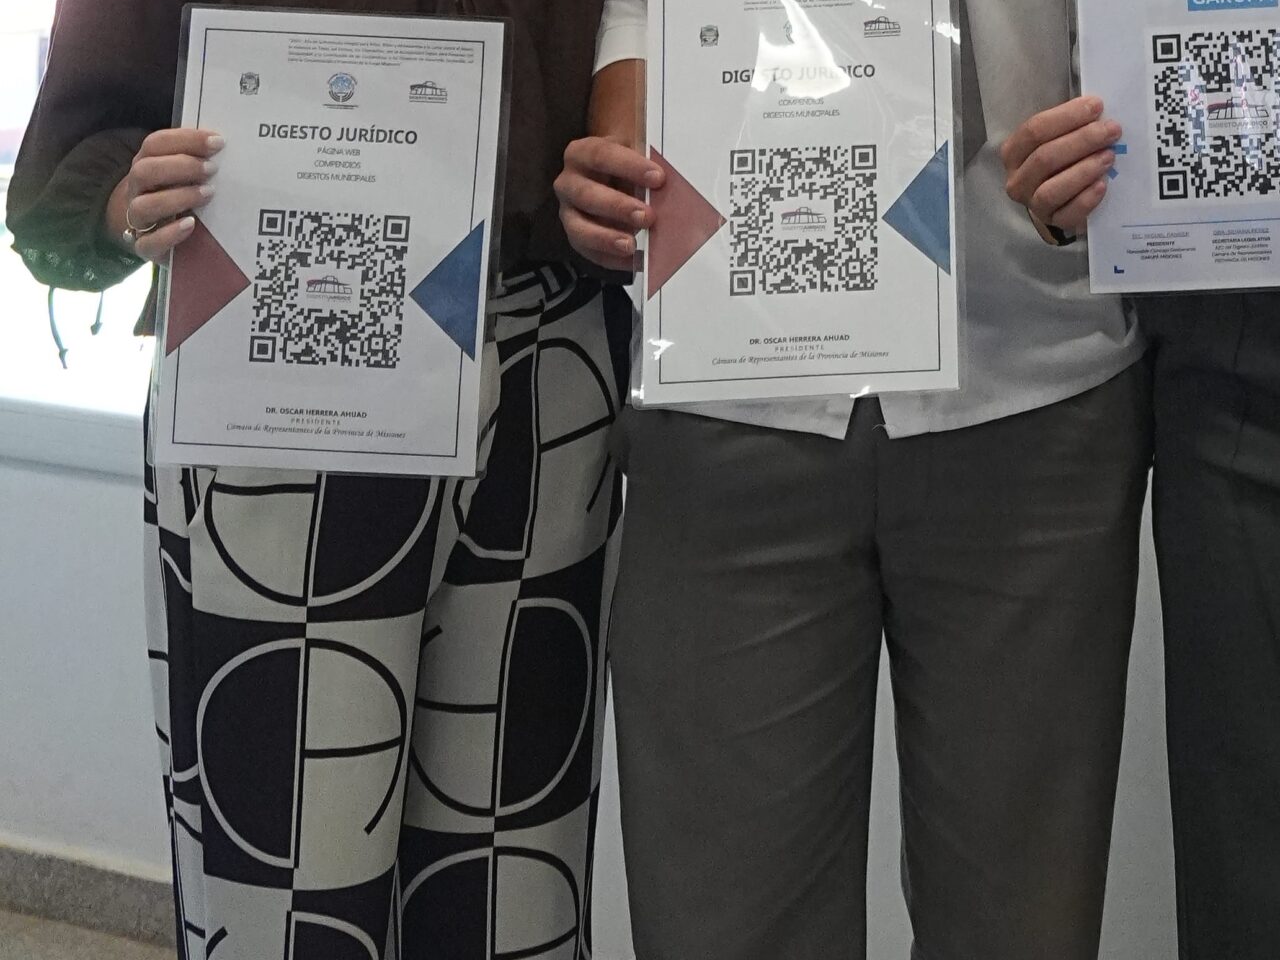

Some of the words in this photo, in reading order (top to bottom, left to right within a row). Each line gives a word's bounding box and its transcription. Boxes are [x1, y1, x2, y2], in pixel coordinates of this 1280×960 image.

[763, 110, 795, 119] DIGESTOS
[795, 109, 840, 118] MUNICIPALES
[258, 123, 332, 141] DIGESTO
[336, 124, 419, 145] JURÍDICO
[345, 147, 361, 156] WEB
[314, 160, 361, 170] COMPENDIOS
[297, 172, 330, 182] DIGESTOS
[331, 172, 376, 182] MUNICIPALES
[823, 334, 850, 342] AHUAD
[265, 406, 278, 415] DR.
[279, 407, 304, 415] OSCAR
[305, 409, 338, 417] HERRERA
[340, 410, 367, 418] AHUAD
